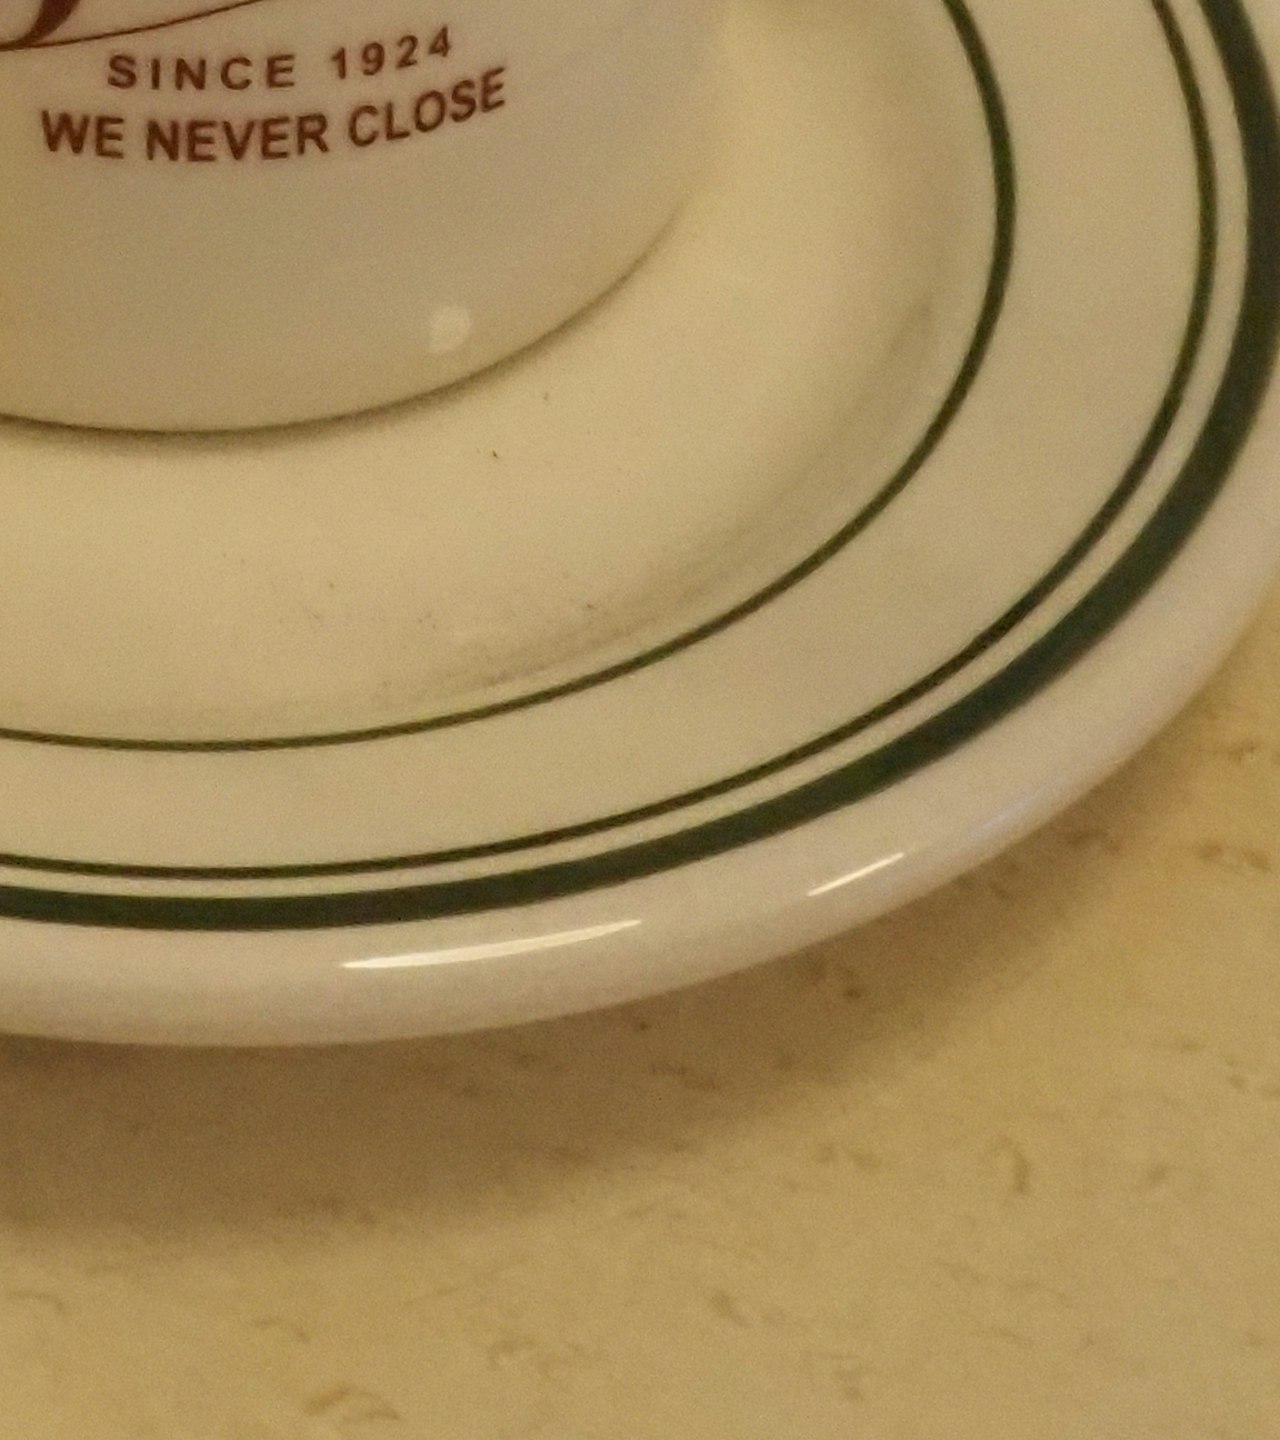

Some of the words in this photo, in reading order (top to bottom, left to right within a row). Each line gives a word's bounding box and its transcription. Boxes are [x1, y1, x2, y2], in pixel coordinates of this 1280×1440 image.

[106, 53, 298, 92] SINCE
[331, 24, 454, 80] 1924
[40, 108, 125, 159] WE
[145, 111, 329, 164] NEVER
[347, 66, 508, 150] CLOSE
